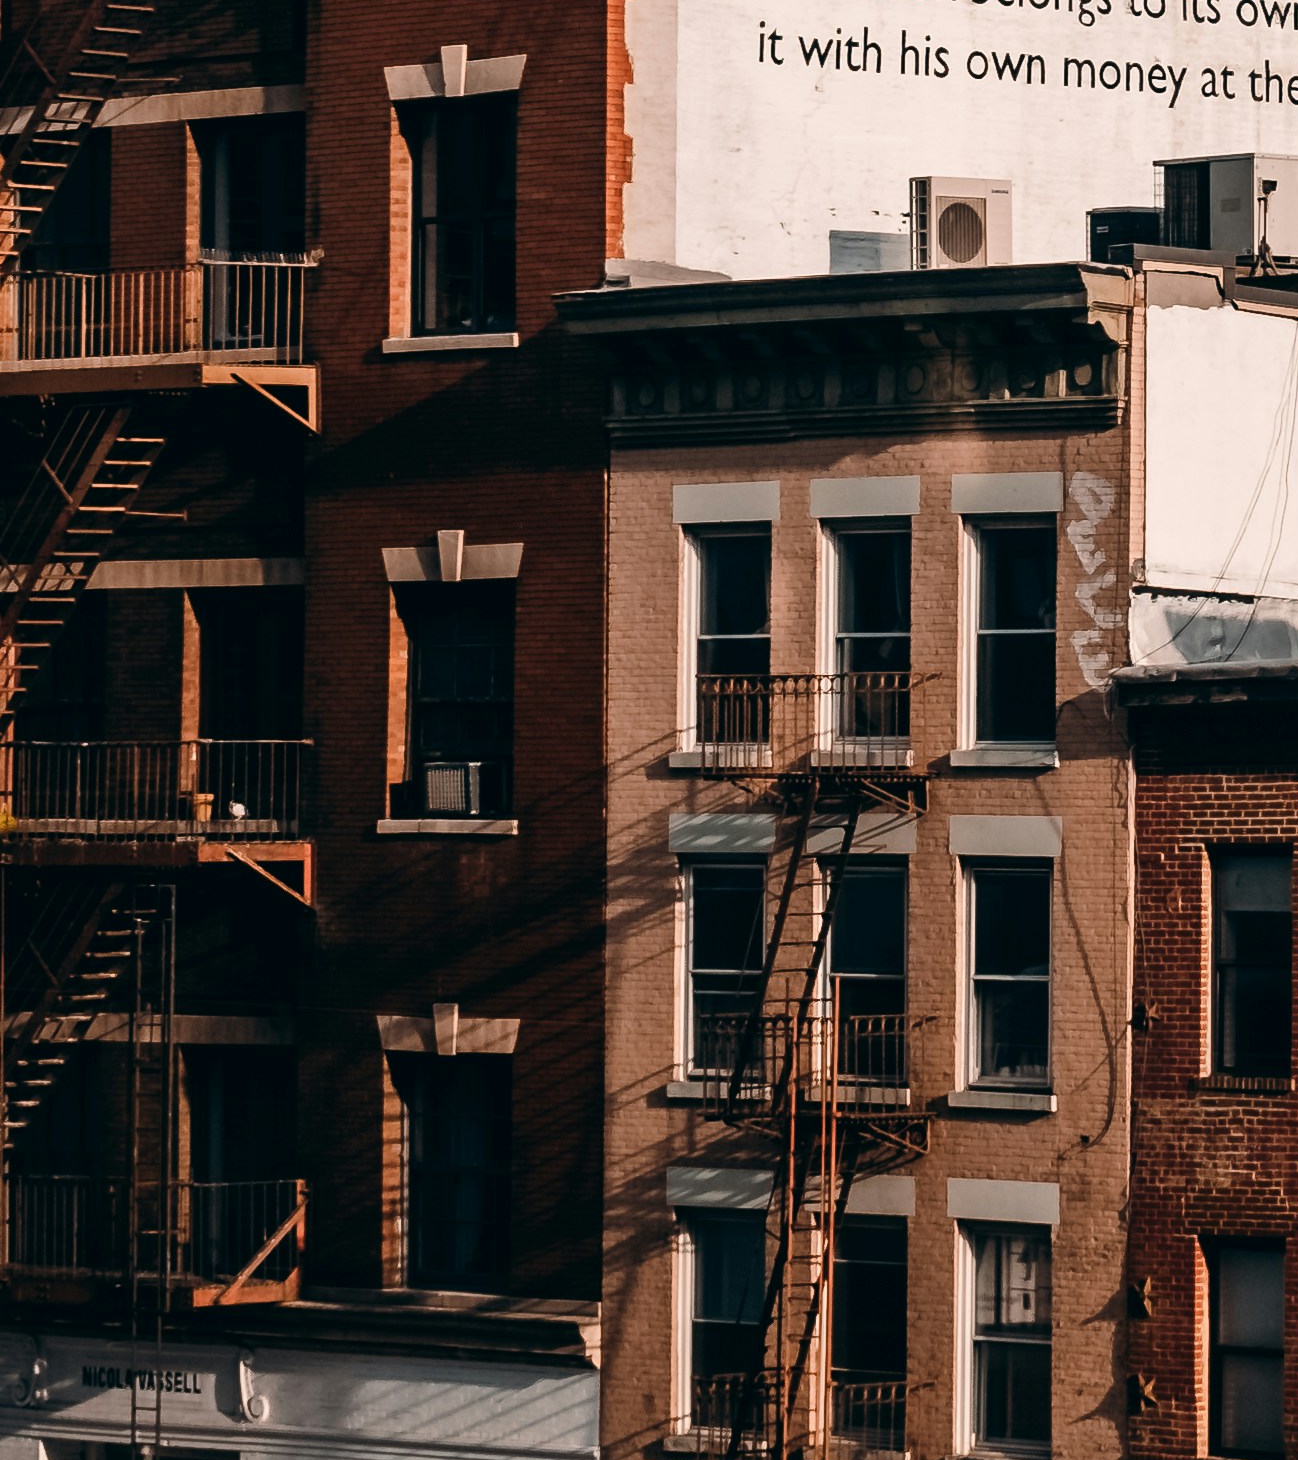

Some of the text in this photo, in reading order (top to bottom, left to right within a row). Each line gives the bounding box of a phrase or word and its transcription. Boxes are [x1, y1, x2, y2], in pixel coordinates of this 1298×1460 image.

[758, 20, 785, 66] it
[798, 26, 882, 74] with
[900, 29, 950, 79] his
[966, 50, 1046, 85] own
[1063, 57, 1188, 109] money
[1201, 65, 1236, 100] at
[82, 1366, 134, 1388] NICOLA
